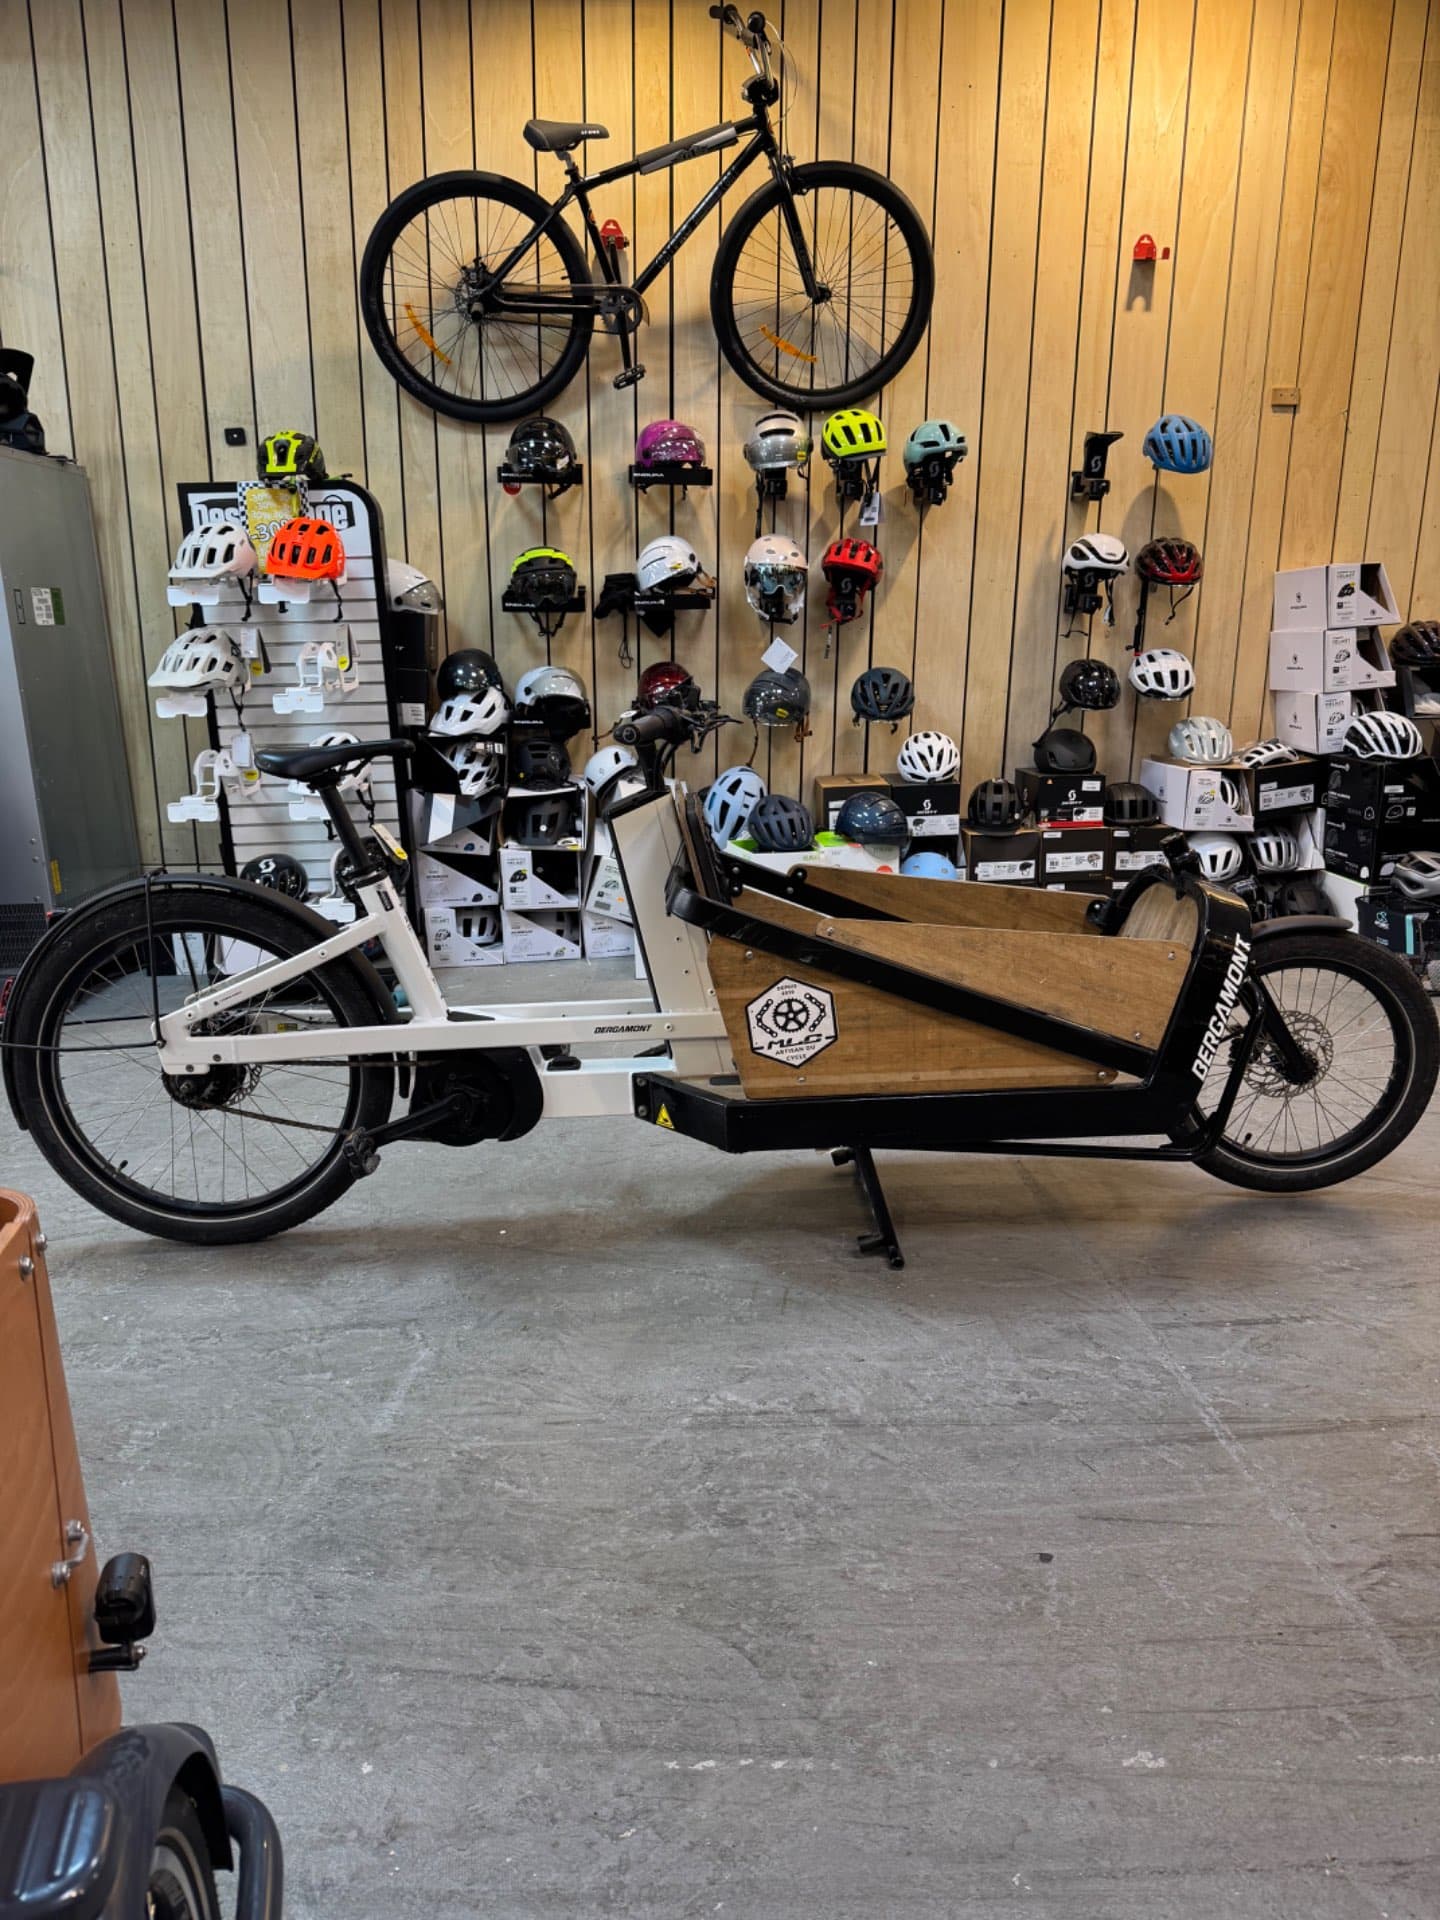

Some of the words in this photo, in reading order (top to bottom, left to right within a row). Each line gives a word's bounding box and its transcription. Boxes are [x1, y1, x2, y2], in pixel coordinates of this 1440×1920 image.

[1191, 932, 1251, 1082] BERGAMONT
[593, 1023, 653, 1034] BERGAMONT
[775, 1047, 804, 1056] ARTISAN
[786, 1053, 807, 1061] CYCLE
